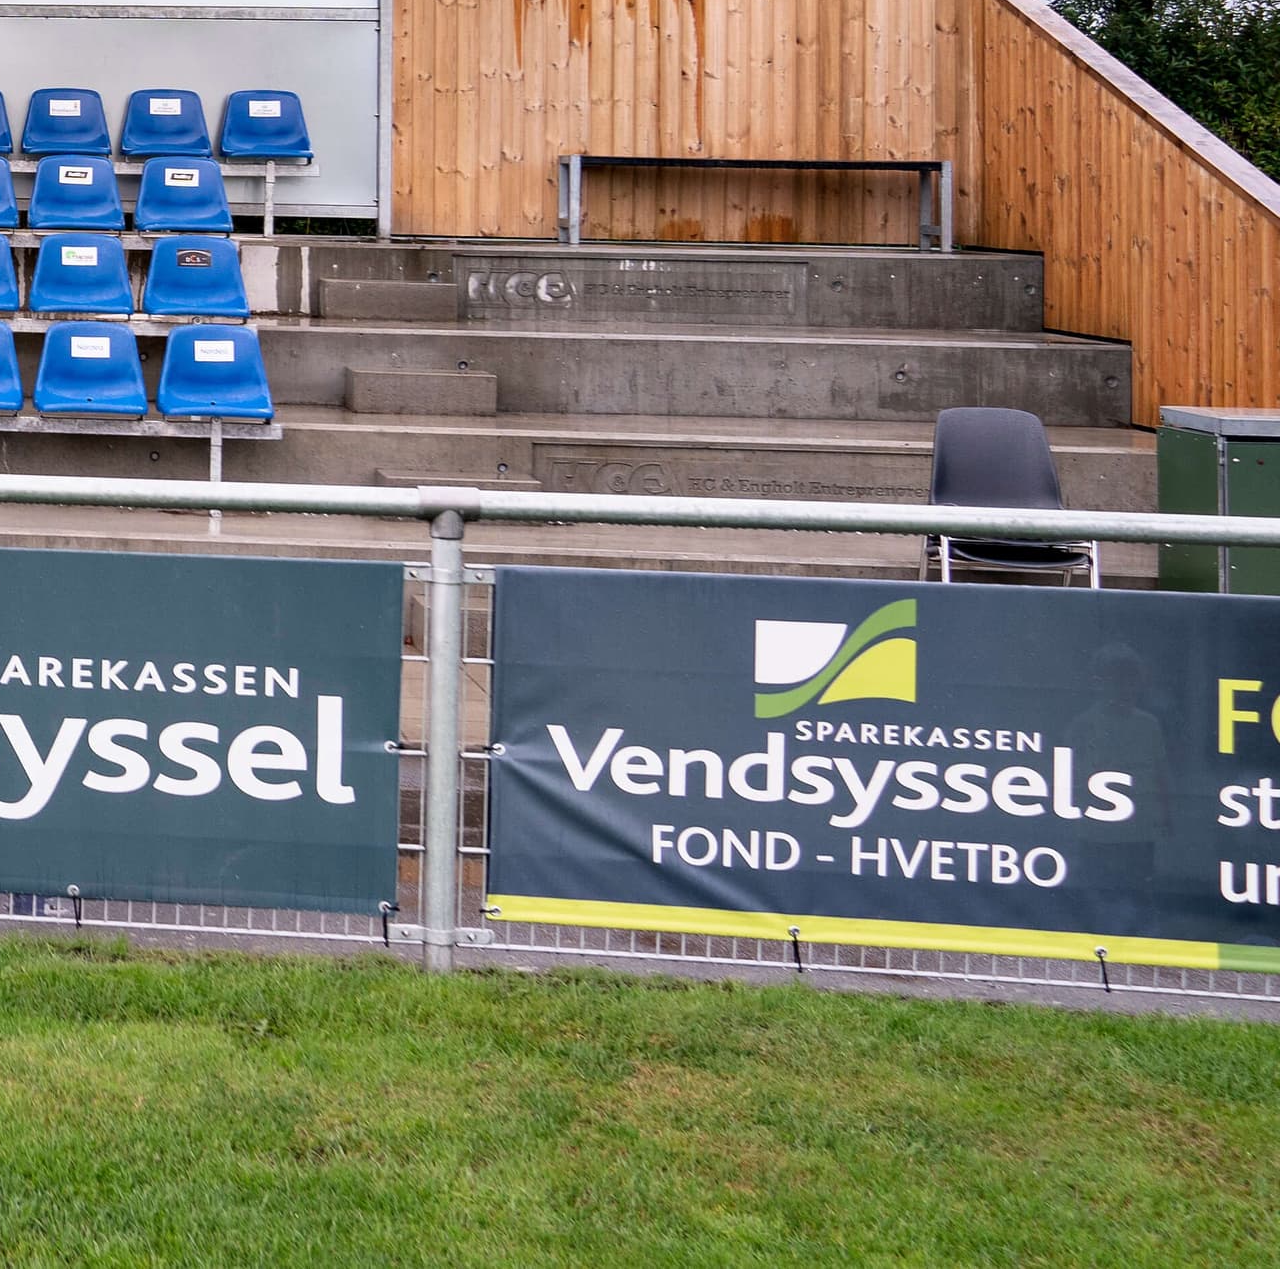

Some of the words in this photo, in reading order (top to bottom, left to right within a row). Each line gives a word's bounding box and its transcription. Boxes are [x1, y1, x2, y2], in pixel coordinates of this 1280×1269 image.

[739, 478, 806, 496] Engholt
[794, 719, 1042, 754] SPAREKASSEN
[1217, 678, 1280, 755] F
[546, 723, 1134, 829] Vendsyssels
[651, 823, 801, 872] FOND
[850, 835, 1068, 889] HVETBO
